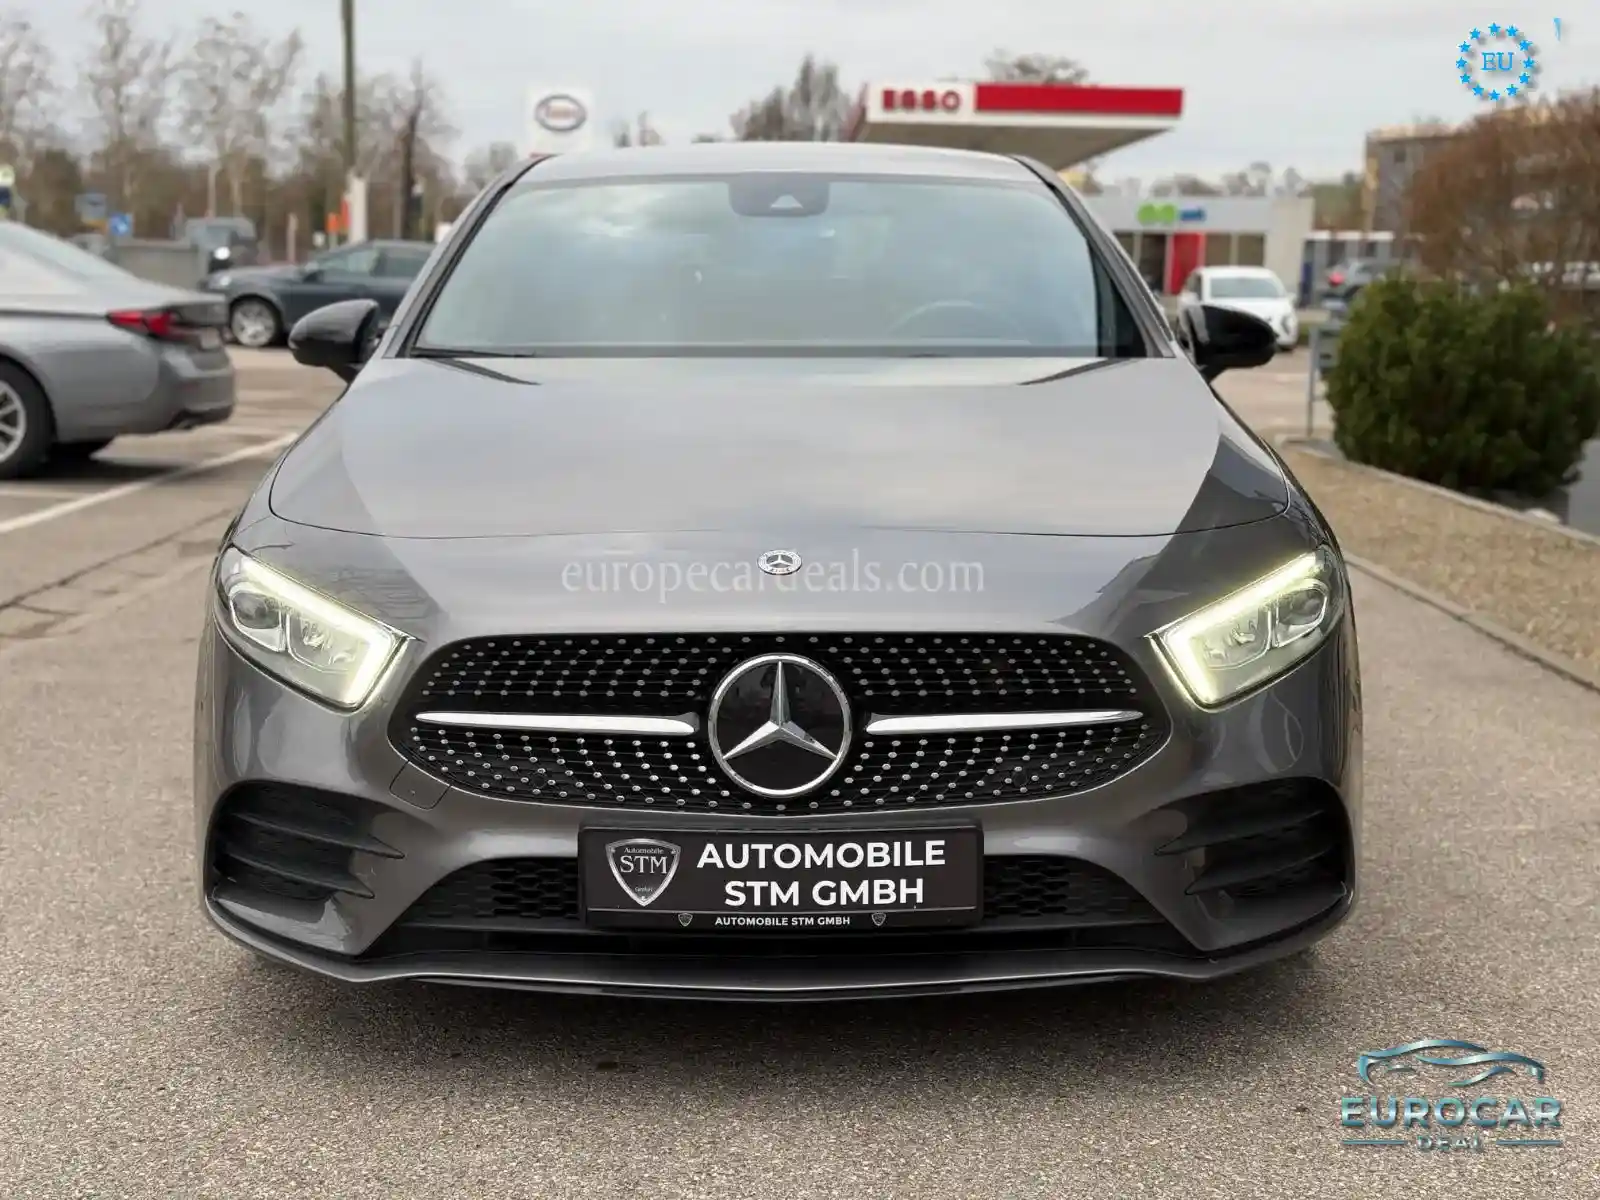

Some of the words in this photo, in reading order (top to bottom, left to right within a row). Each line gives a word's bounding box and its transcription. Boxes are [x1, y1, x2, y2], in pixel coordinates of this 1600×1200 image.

[620, 855, 668, 874] STM
[697, 840, 946, 869] AUTOMOBILE
[725, 881, 800, 906] STM
[812, 878, 924, 906] GMBH
[714, 916, 788, 926] AUTOMOBILE
[791, 916, 814, 926] STM
[817, 916, 850, 925] GMBH
